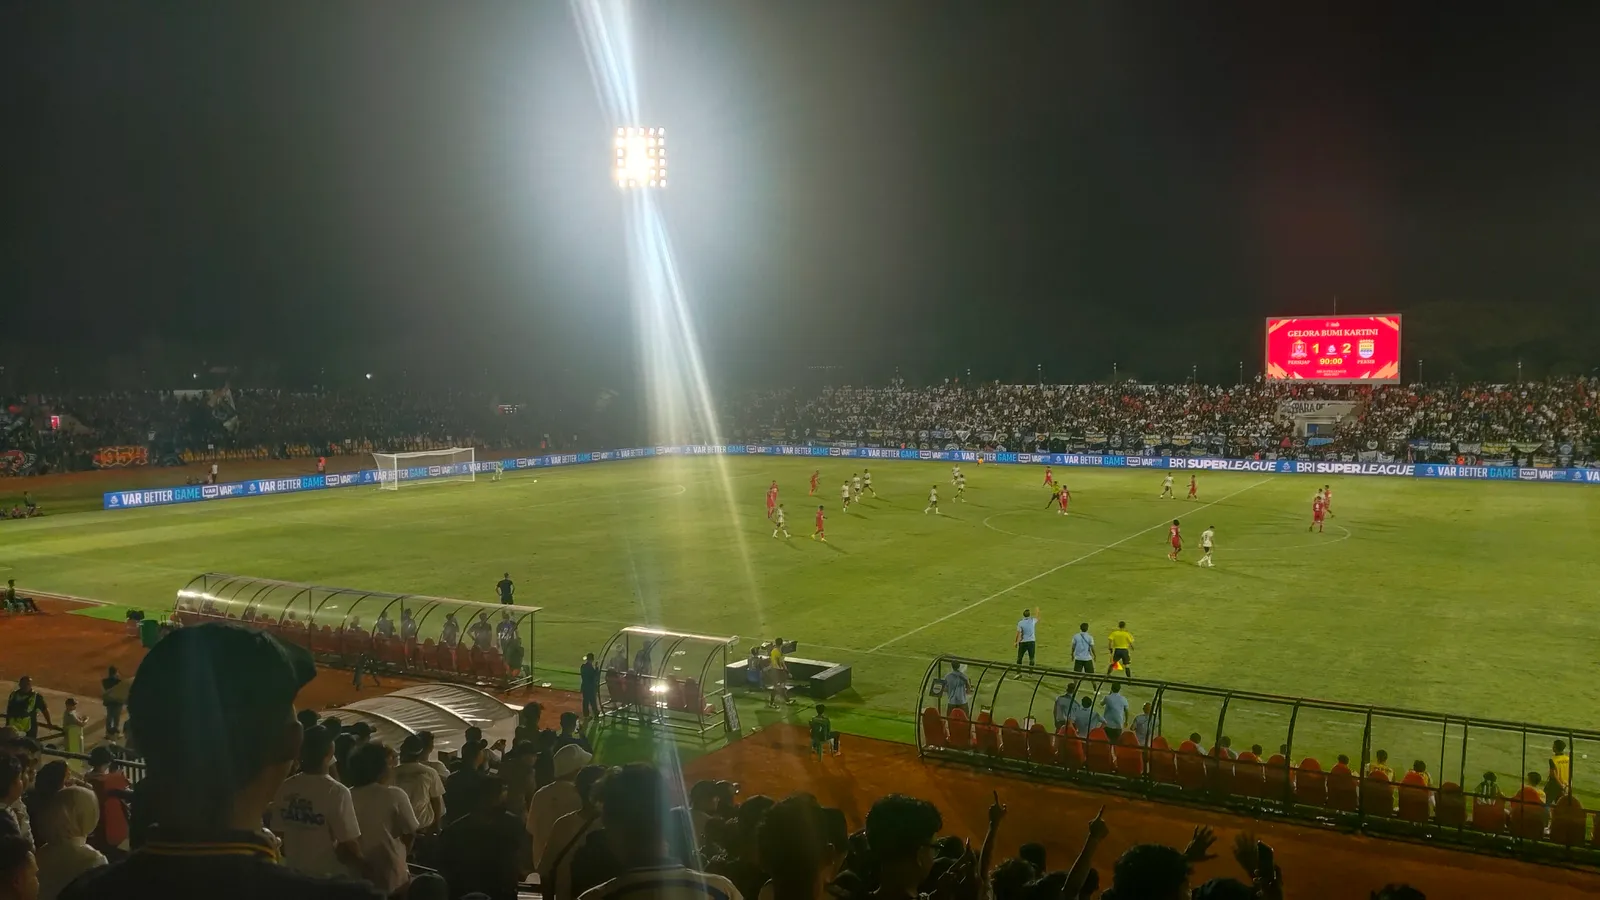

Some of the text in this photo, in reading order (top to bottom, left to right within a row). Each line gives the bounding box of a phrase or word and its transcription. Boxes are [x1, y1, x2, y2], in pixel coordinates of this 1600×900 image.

[1321, 329, 1343, 337] BUMI
[1343, 328, 1379, 336] KARTINI
[1312, 343, 1319, 354] 1
[1342, 343, 1352, 354] 2
[693, 446, 706, 455] VAR
[707, 445, 727, 453] BETTER
[727, 445, 745, 454] GAME
[782, 446, 829, 456] VAR BETTER GAME
[867, 449, 919, 459] VAR BETTER GAME
[932, 451, 942, 459] VAR
[551, 456, 562, 464] VAR
[562, 454, 577, 463] BETTER
[961, 452, 975, 461] VAR
[997, 453, 1017, 462] GAME
[1064, 456, 1125, 466] VAR BETTER GAME
[1141, 458, 1153, 466] VAR
[1169, 458, 1187, 469] BRI
[1296, 462, 1315, 473] BRI
[372, 471, 387, 482] VAR
[388, 469, 409, 480] BETER
[409, 467, 428, 478] GAME
[1437, 466, 1518, 479] VAR BETTER GAME
[1539, 470, 1554, 480] VAR
[258, 481, 276, 493] VAR
[277, 478, 302, 491] BETTER
[302, 476, 325, 488] GAME
[219, 486, 233, 496] VAR
[121, 487, 201, 506] VAR BETTER GAME
